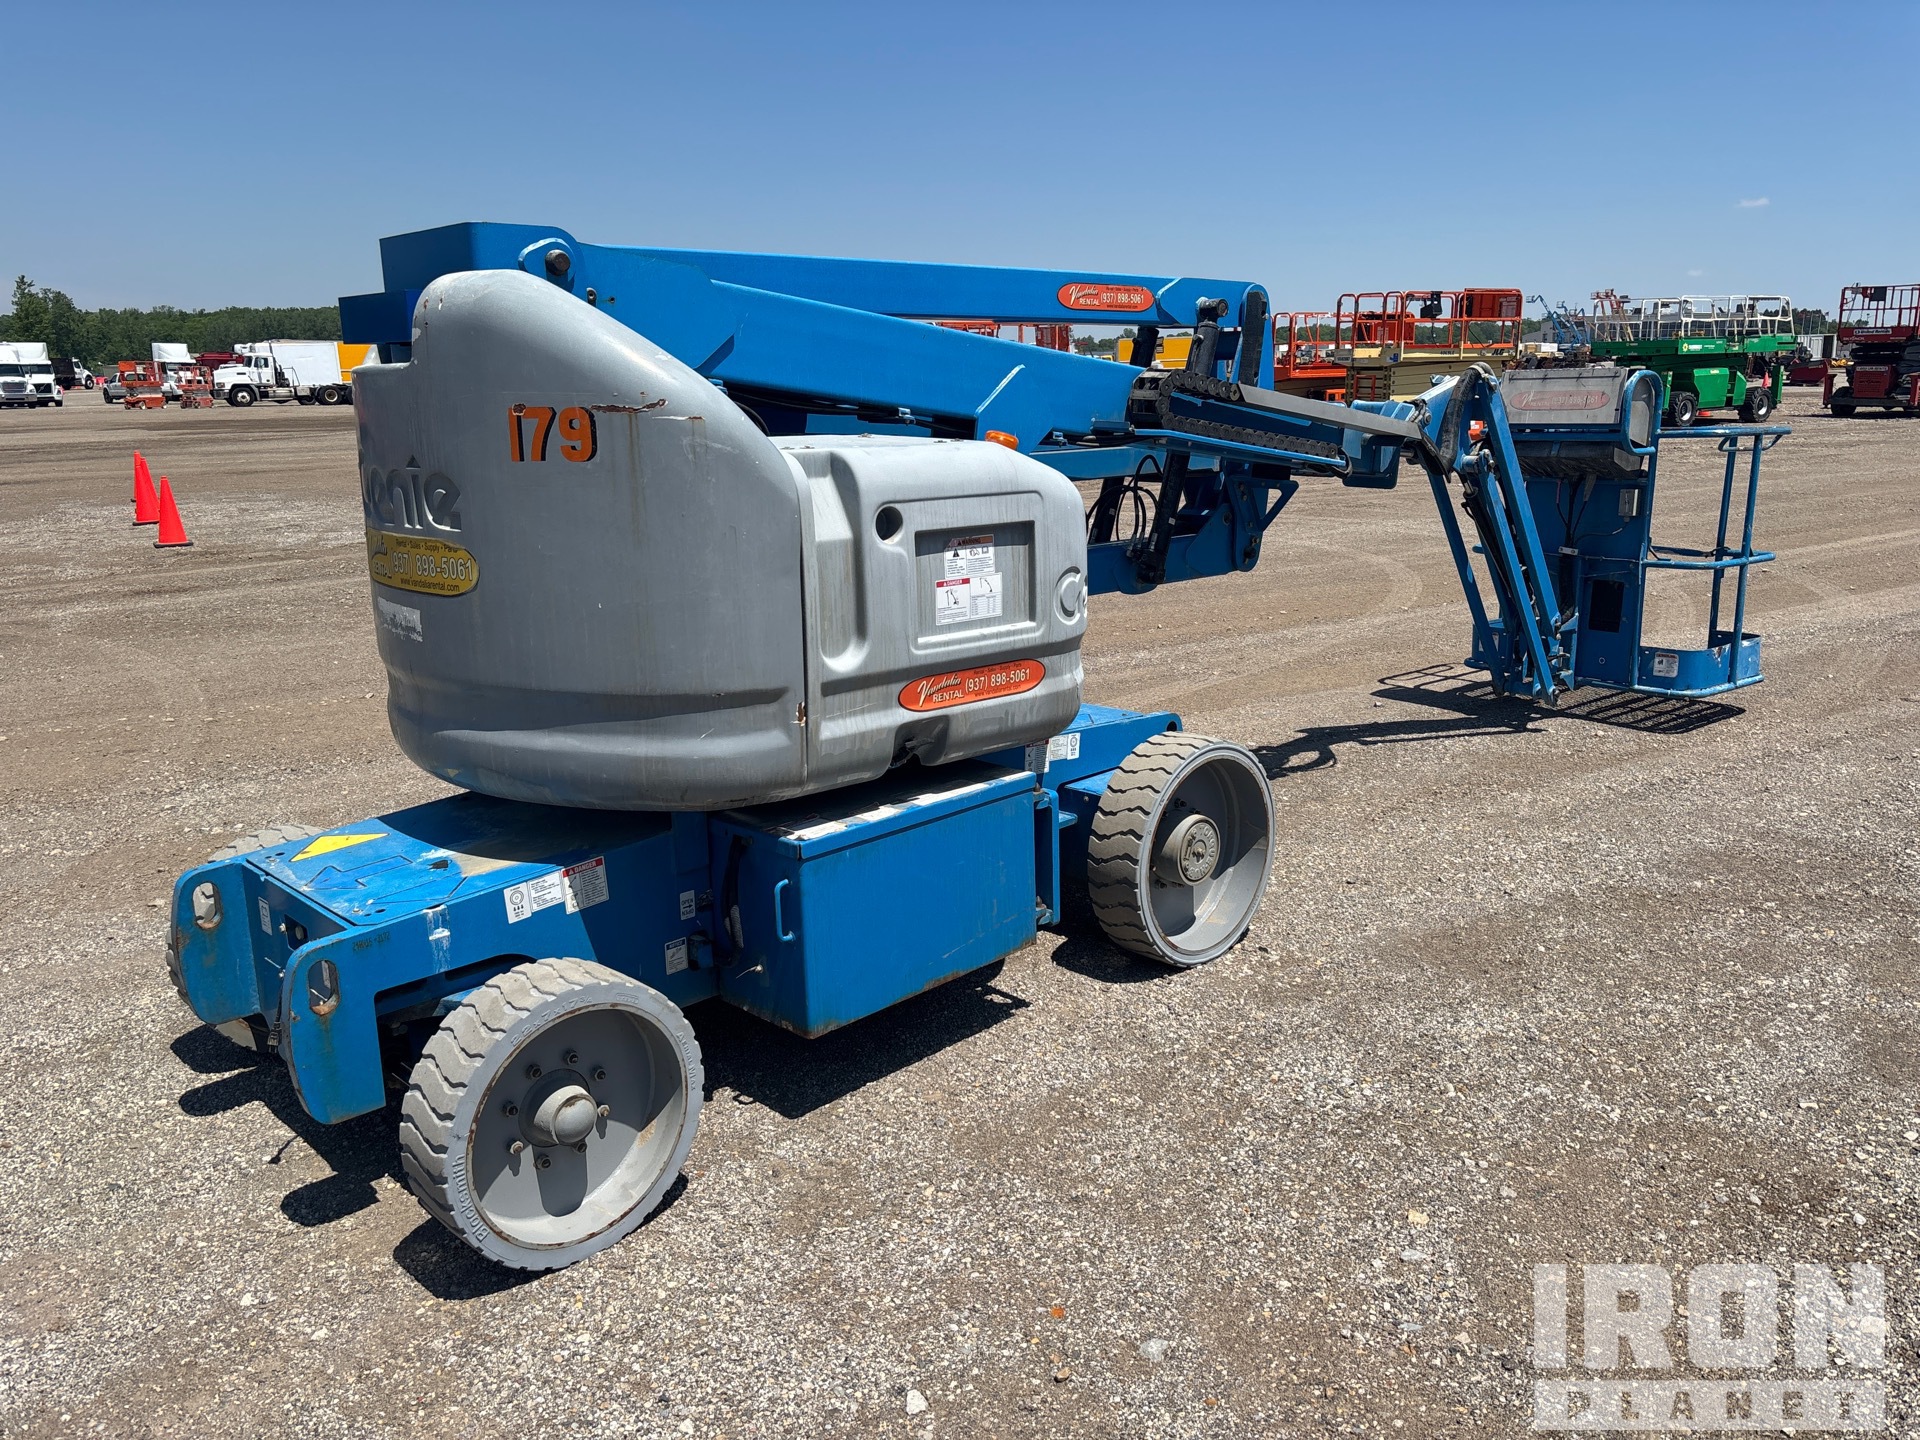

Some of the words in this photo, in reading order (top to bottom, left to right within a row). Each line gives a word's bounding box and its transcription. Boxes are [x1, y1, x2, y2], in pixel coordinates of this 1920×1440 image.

[1079, 297, 1100, 306] RENTAL
[1100, 292, 1116, 304] (937)
[1117, 292, 1144, 304] 898-5061
[508, 404, 598, 462] 179
[425, 542, 440, 553] Supply
[415, 554, 473, 581] 898-5061
[917, 672, 962, 707] Vandalia
[965, 675, 988, 693] (937)
[990, 668, 1030, 687] 898-5061
[932, 689, 964, 703] RENTAL
[574, 860, 597, 873] DANGER
[452, 1153, 490, 1243] Blacksmith
